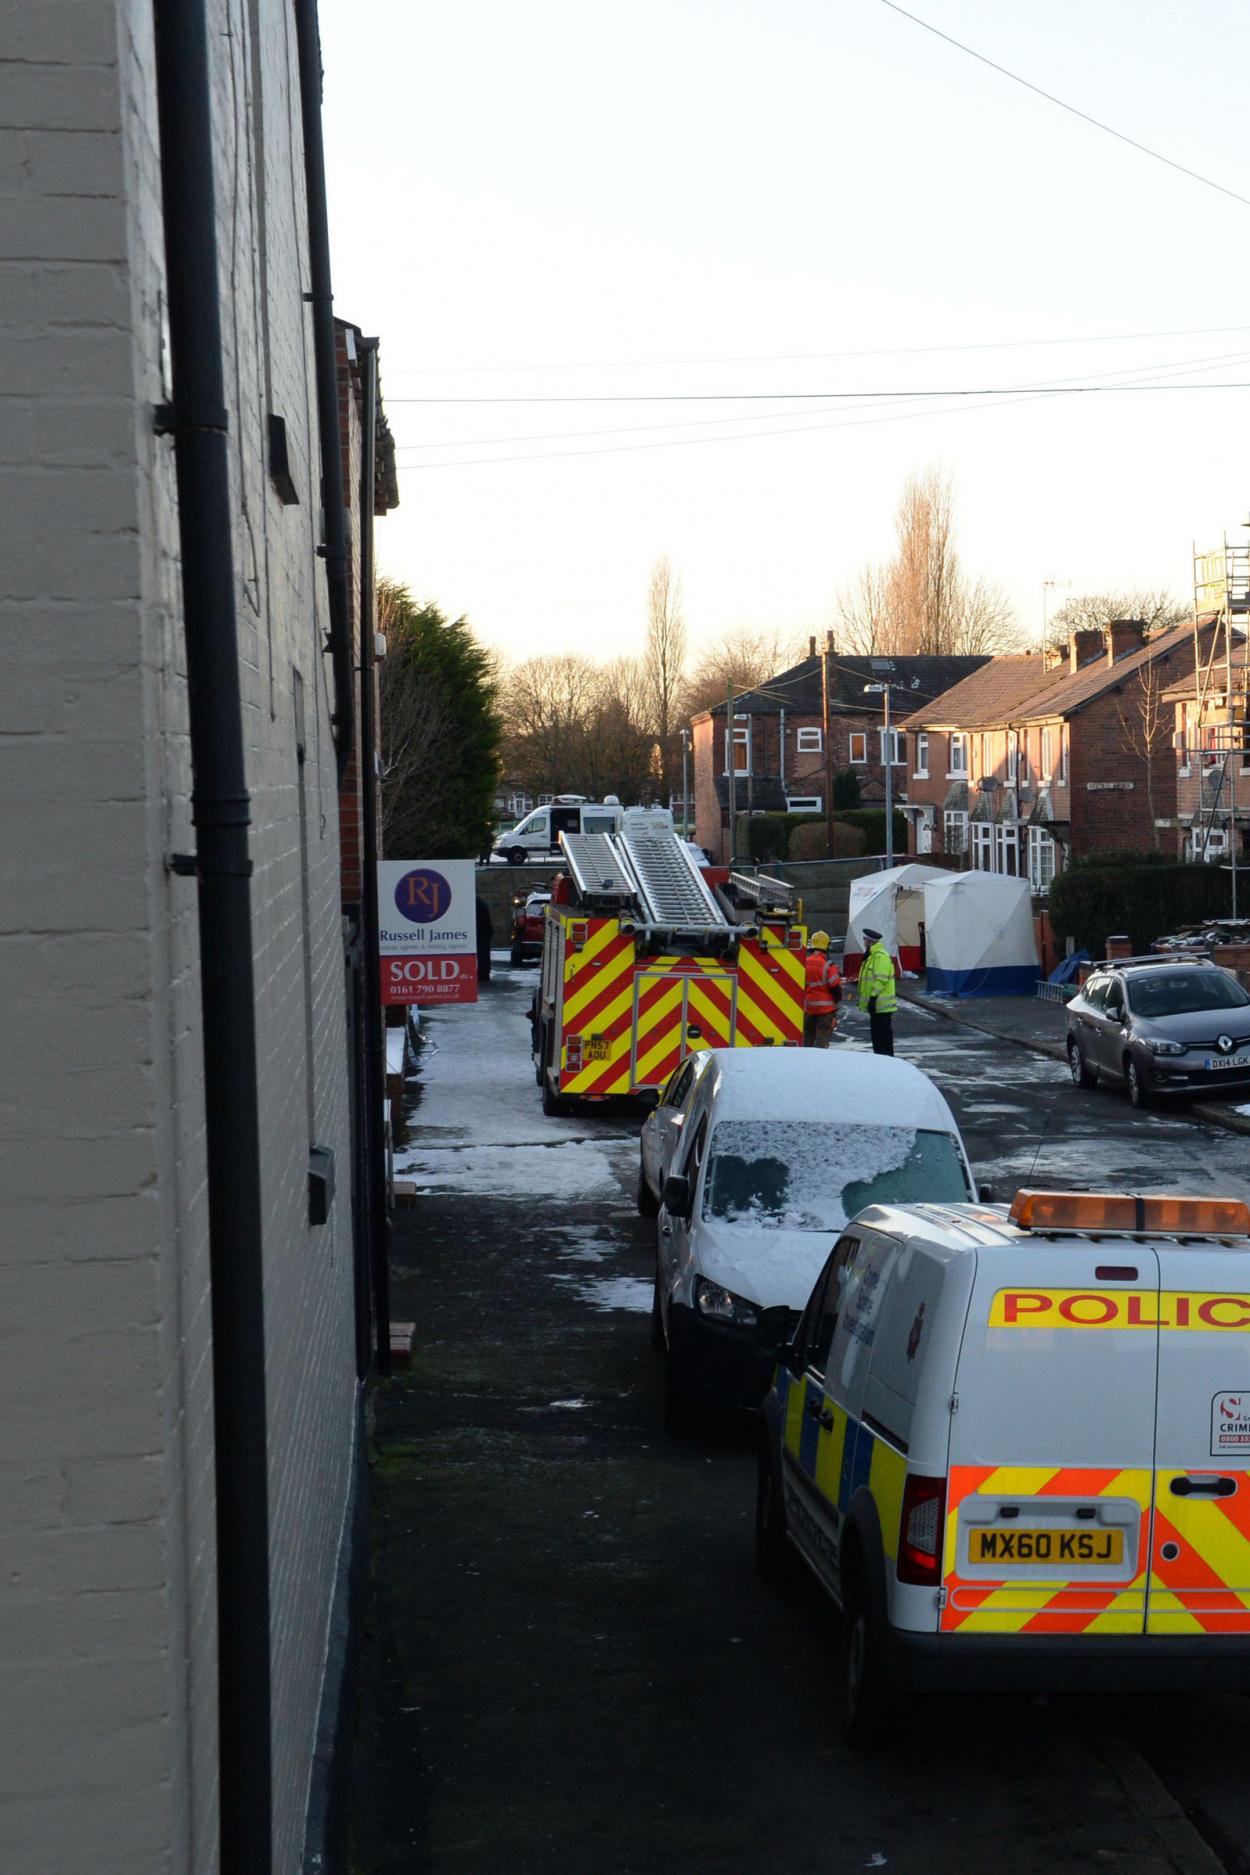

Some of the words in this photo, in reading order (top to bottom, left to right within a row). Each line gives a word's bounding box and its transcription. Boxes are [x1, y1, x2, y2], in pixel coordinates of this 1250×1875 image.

[406, 876, 441, 918] RJ
[380, 929, 425, 942] Russell
[429, 929, 468, 942] James
[390, 960, 460, 981] SOLD
[390, 985, 413, 994] 0161
[417, 985, 435, 993] 790
[436, 984, 460, 993] 8877
[1212, 1058, 1230, 1068] DX14
[1232, 1056, 1249, 1066] LGK
[980, 1533, 1051, 1558] MX60
[1060, 1534, 1112, 1559] KSJ
